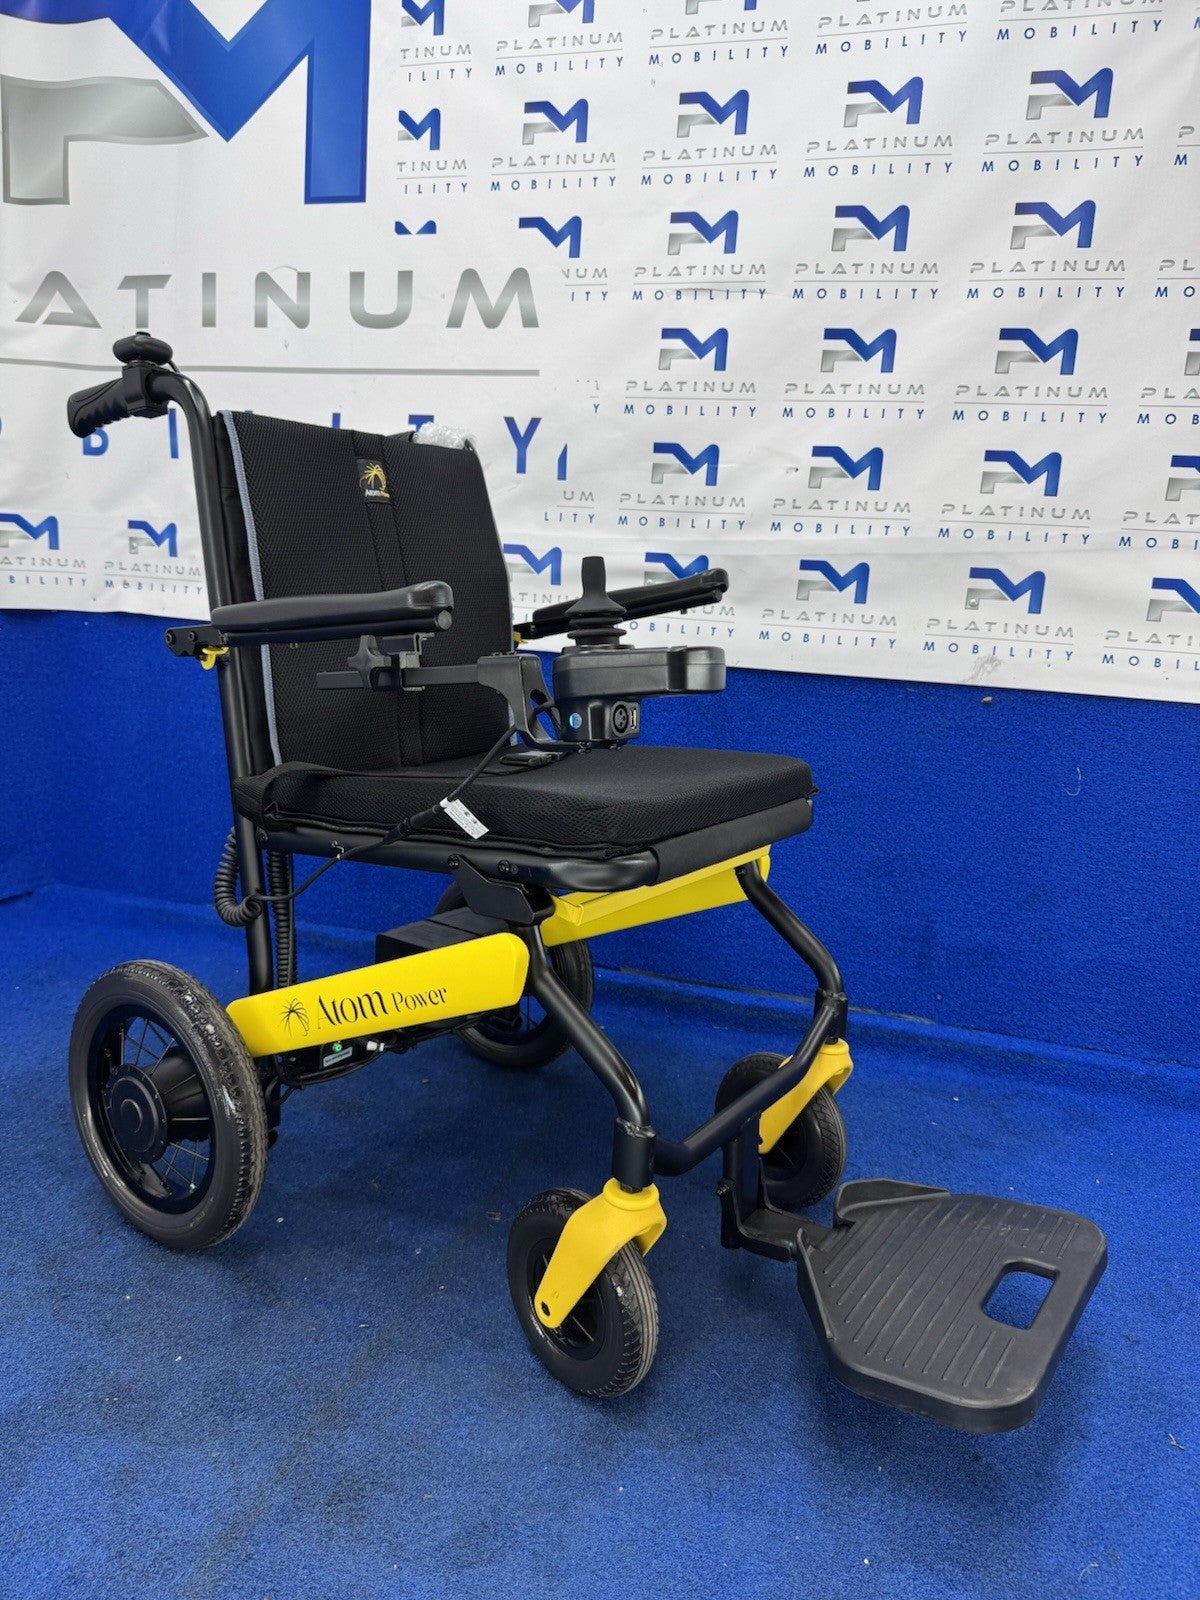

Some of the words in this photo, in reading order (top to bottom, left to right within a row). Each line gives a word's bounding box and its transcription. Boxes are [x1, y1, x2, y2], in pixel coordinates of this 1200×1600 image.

[817, 4, 968, 29] PLATINUM
[650, 19, 789, 41] PLATINUM
[996, 19, 1163, 41] MOBILITY
[496, 31, 624, 53] PLATINUM
[815, 30, 968, 56] MOBILITY
[648, 45, 789, 66] MOBILITY
[495, 56, 624, 77] MOBILITY
[806, 133, 954, 154] PLATINUM
[984, 126, 1145, 147] PLATINUM
[491, 151, 617, 170] PLATINUM
[642, 143, 778, 162] PLATINUM
[803, 161, 953, 178] MOBILITY
[981, 155, 1144, 173] MOBILITY
[490, 175, 617, 193] MOBILITY
[640, 167, 778, 187] MOBILITY
[634, 263, 767, 278] PLATINUM
[794, 261, 940, 276] PLATINUM
[969, 259, 1127, 275] PLATINUM
[631, 289, 767, 301] MOBILITY
[791, 288, 940, 300] MOBILITY
[966, 286, 1127, 300] MOBILITY
[625, 380, 757, 394] PLATINUM
[785, 383, 926, 397] PLATINUM
[955, 384, 1109, 400] PLATINUM
[624, 403, 757, 417] MOBILITY
[782, 407, 925, 421] MOBILITY
[952, 410, 1108, 425] MOBILITY
[620, 492, 746, 508] PLATINUM
[773, 498, 912, 515] PLATINUM
[941, 503, 1092, 521] PLATINUM
[617, 515, 746, 531] MOBILITY
[770, 521, 911, 537] MOBILITY
[938, 527, 1092, 546] MOBILITY
[104, 561, 202, 577] PLATINUM
[761, 608, 898, 627] PLATINUM
[926, 618, 1074, 638] PLATINUM
[758, 631, 898, 649] MOBILITY
[923, 641, 1074, 662] MOBILITY
